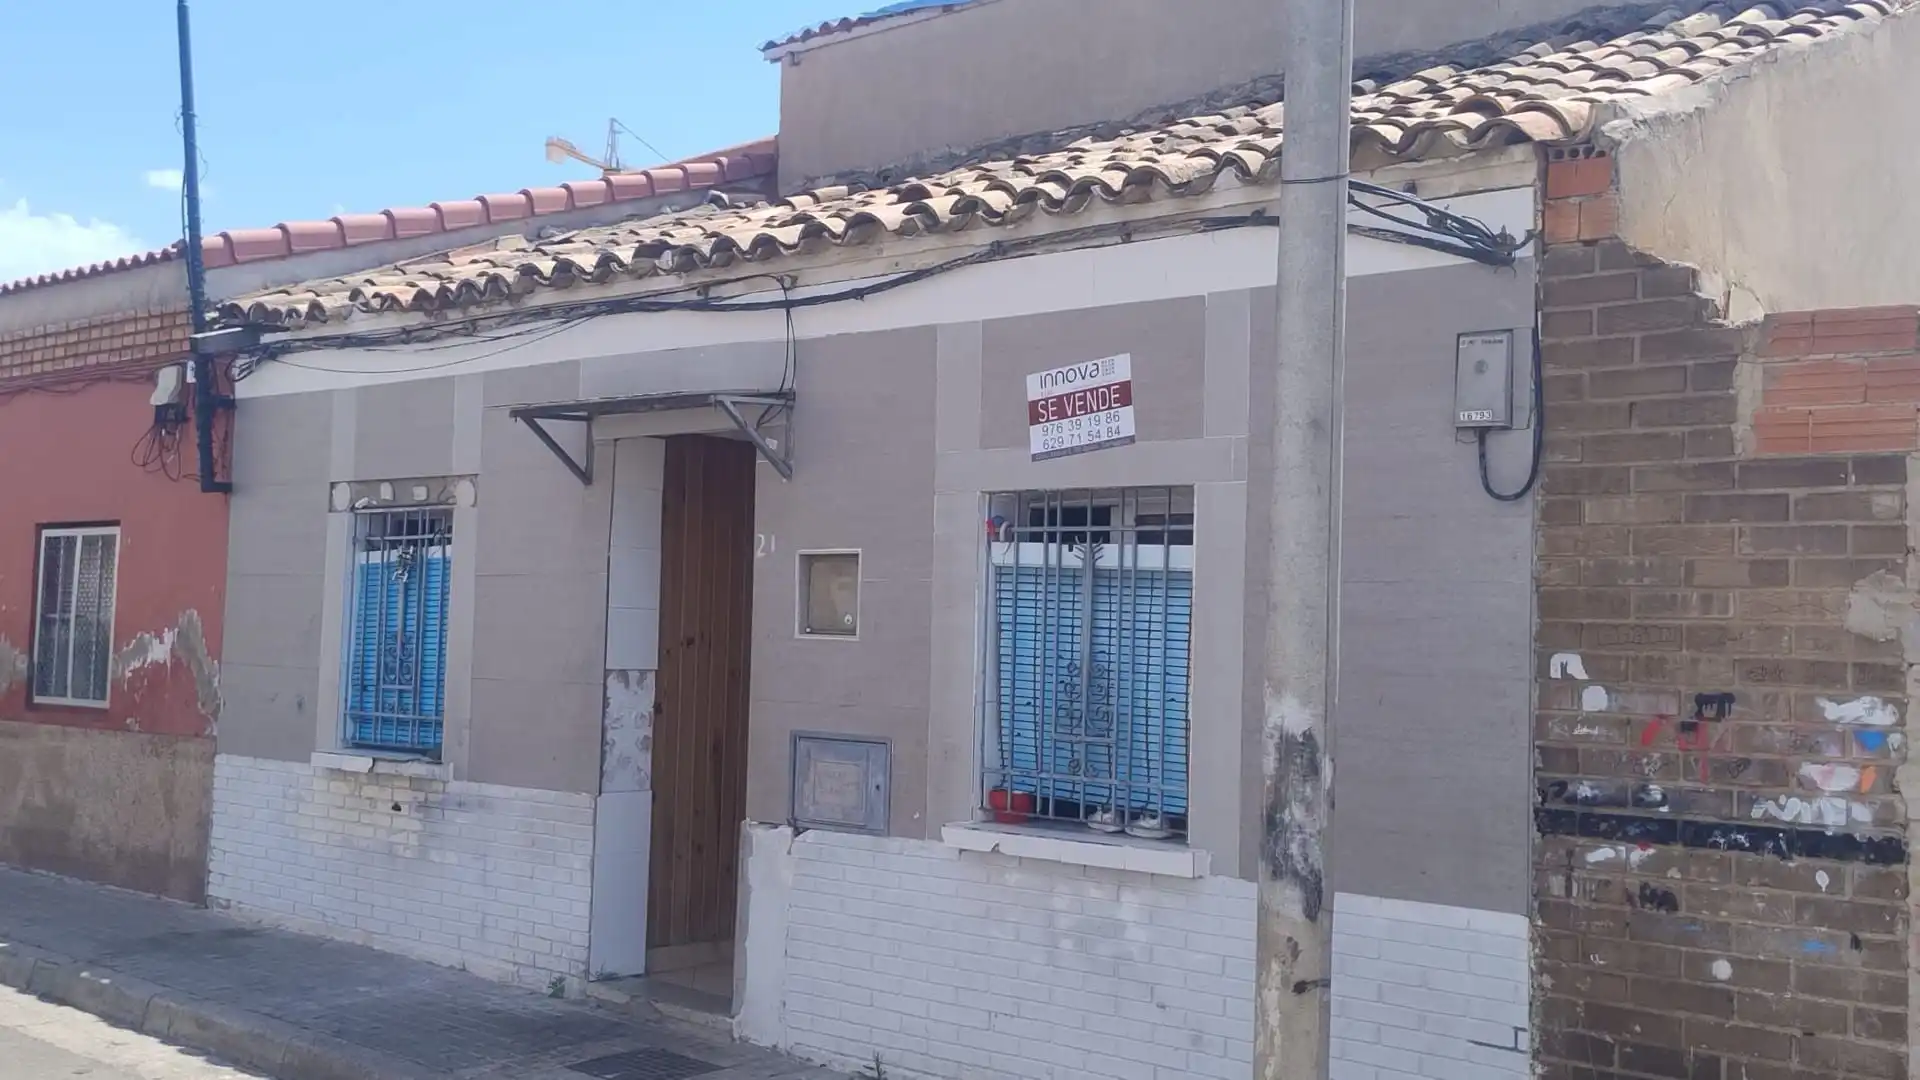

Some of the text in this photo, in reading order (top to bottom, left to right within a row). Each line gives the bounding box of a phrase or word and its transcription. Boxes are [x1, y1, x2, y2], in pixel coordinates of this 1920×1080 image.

[1040, 362, 1100, 389] innova
[1038, 385, 1121, 422] SE VENDE
[1041, 410, 1120, 437] 976 39 19 86
[1043, 436, 1065, 450] 629
[1069, 433, 1082, 445] 71
[1087, 430, 1101, 442] 54
[1106, 426, 1121, 438] 84
[757, 533, 776, 558] 21
